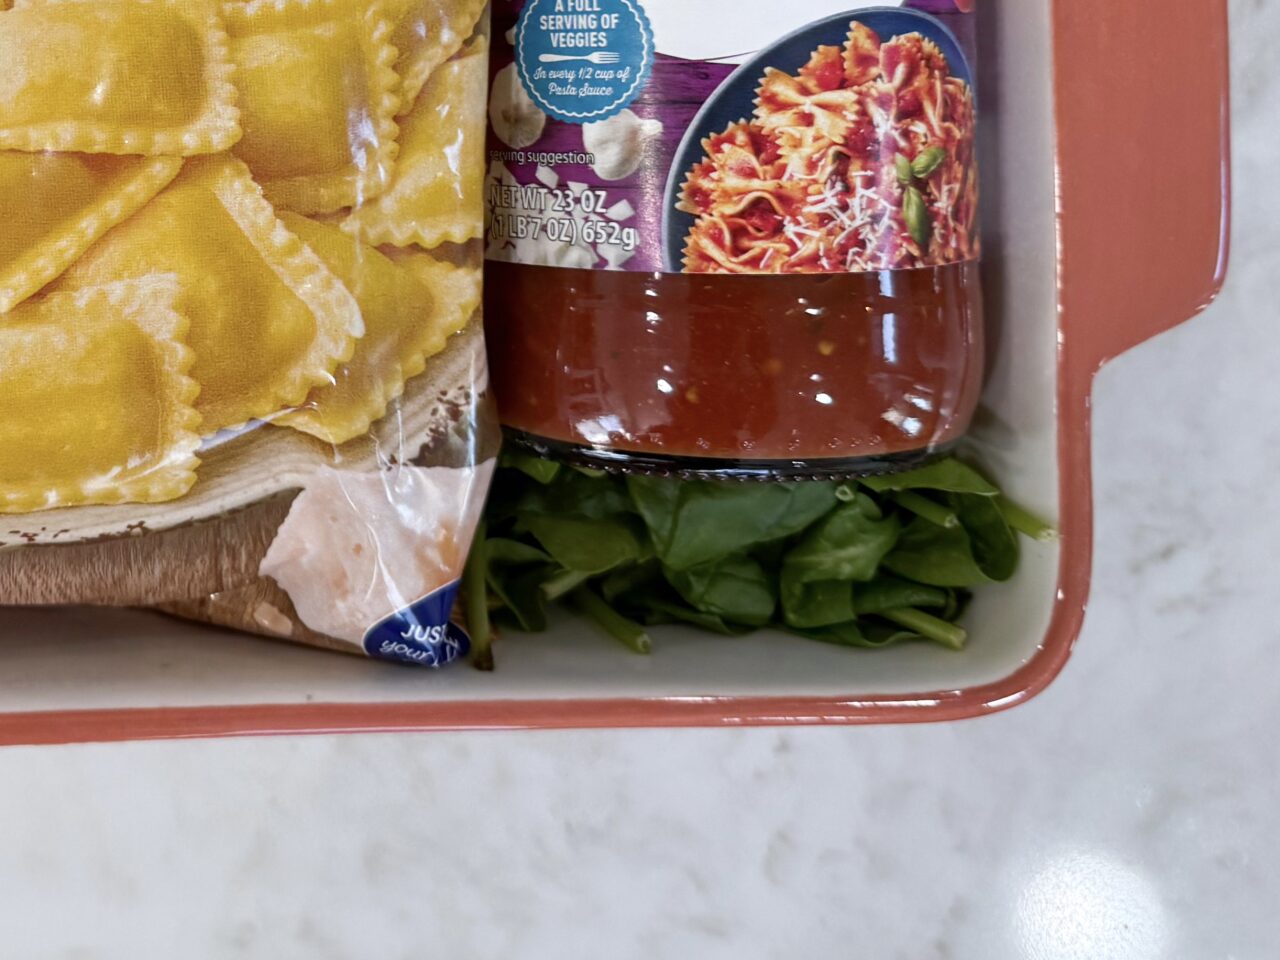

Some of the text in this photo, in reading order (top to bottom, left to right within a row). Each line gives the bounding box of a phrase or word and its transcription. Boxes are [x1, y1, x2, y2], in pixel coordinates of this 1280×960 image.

[540, 13, 619, 30] SERVING OF
[550, 32, 608, 48] VEGGIES
[533, 65, 631, 83] In every 1/2 cup of
[548, 82, 614, 98] Pasta Sauce
[527, 150, 595, 167] suggestion
[490, 186, 608, 214] NET WT 23 OZ
[491, 215, 636, 251] (1 LB 7 OZ) 652g
